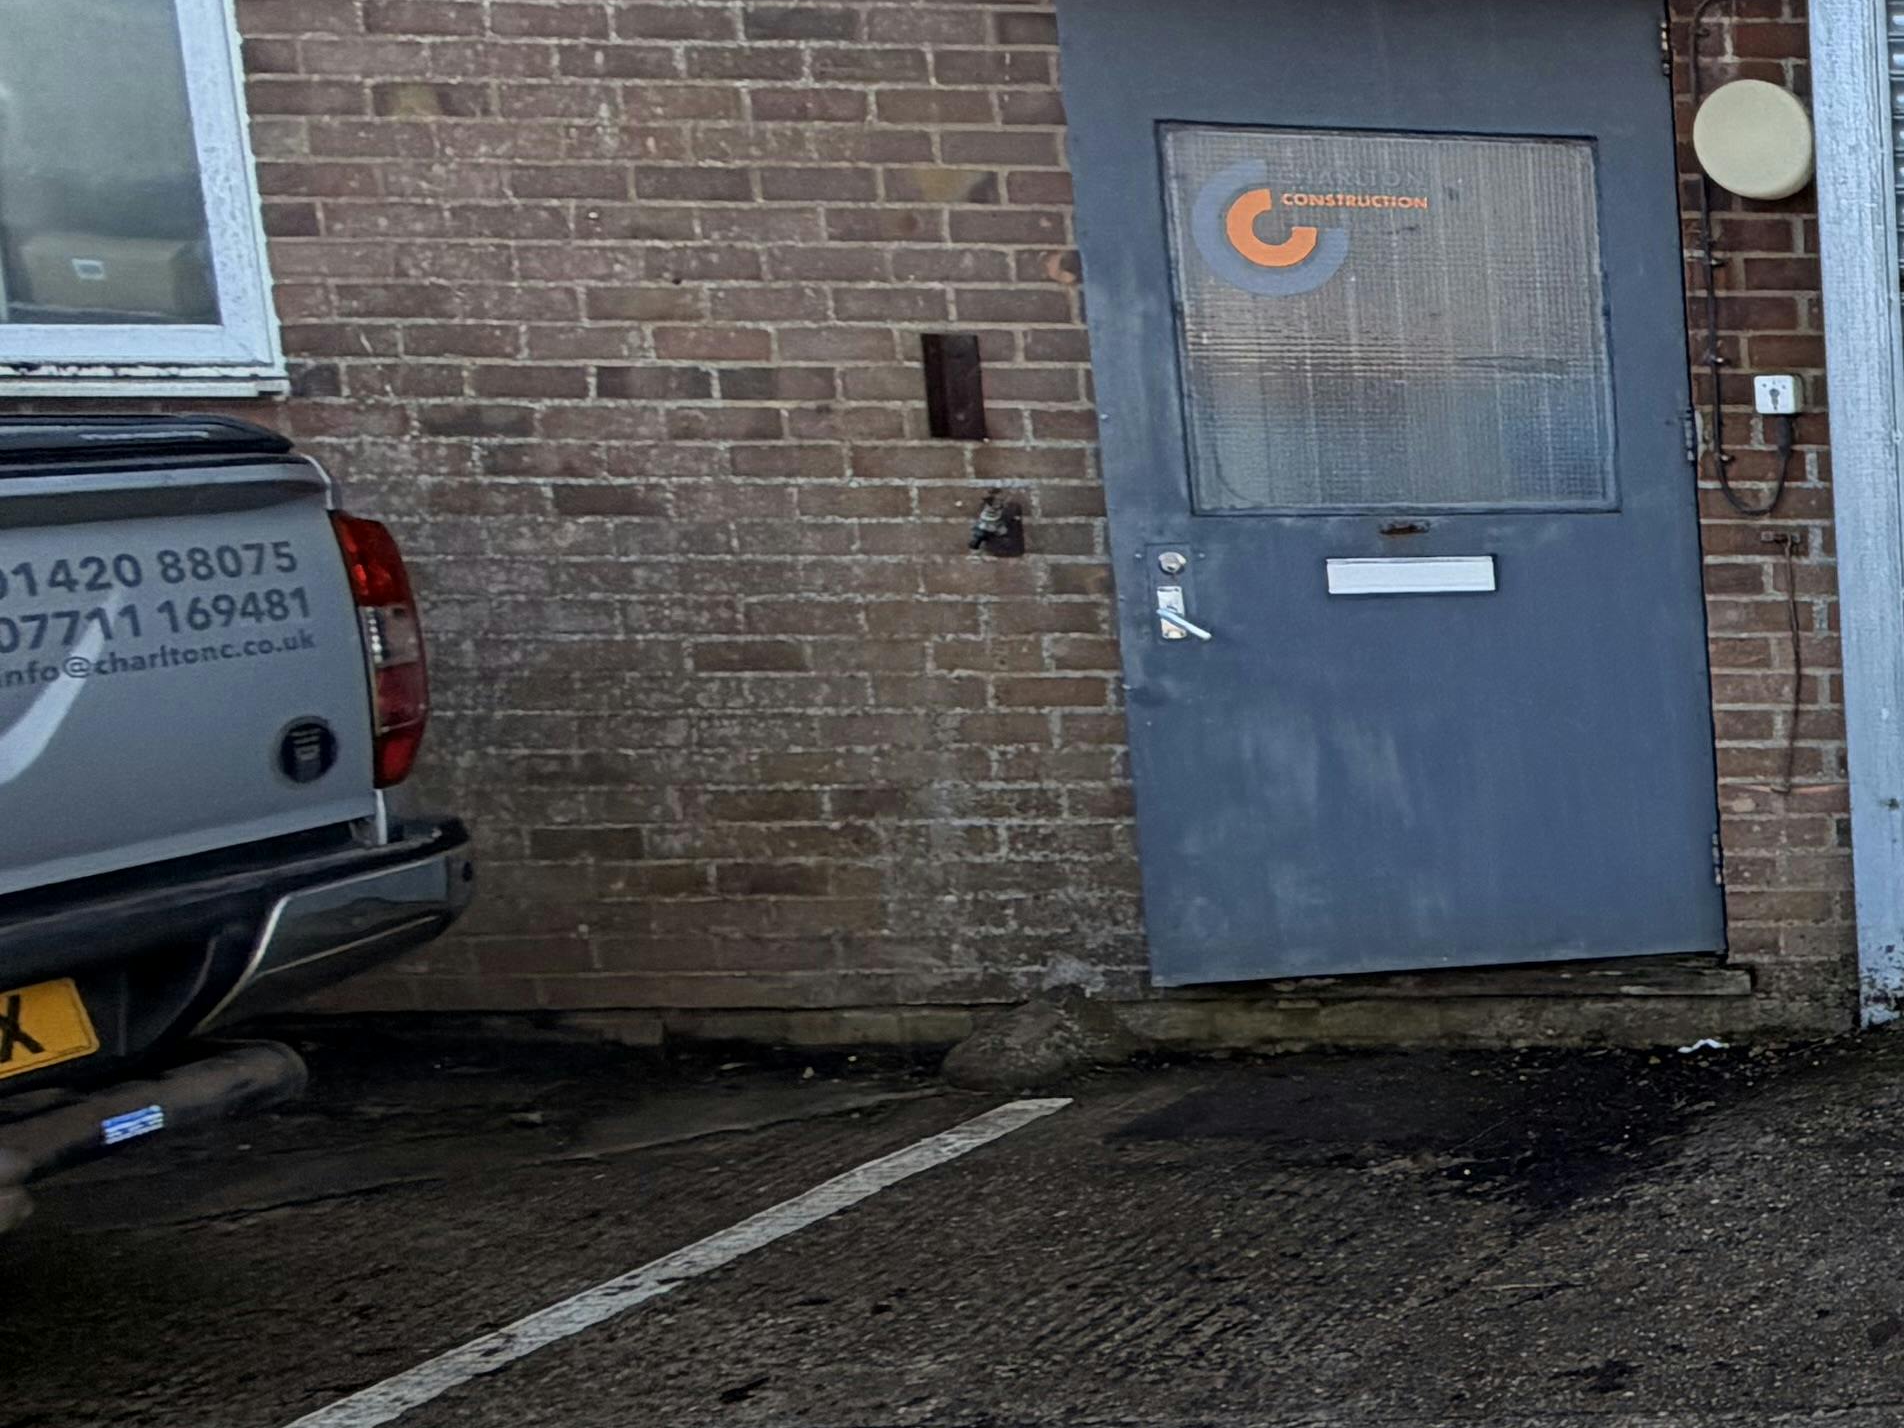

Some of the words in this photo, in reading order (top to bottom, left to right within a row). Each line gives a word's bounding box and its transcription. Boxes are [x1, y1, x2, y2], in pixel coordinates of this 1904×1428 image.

[1281, 192, 1429, 209] CONSTRUCTION
[0, 553, 143, 600] 1420
[156, 540, 298, 585] 88075
[0, 603, 142, 653] 07711
[156, 585, 311, 634] 169481
[0, 627, 316, 688] nfo@charltonc.co.uk
